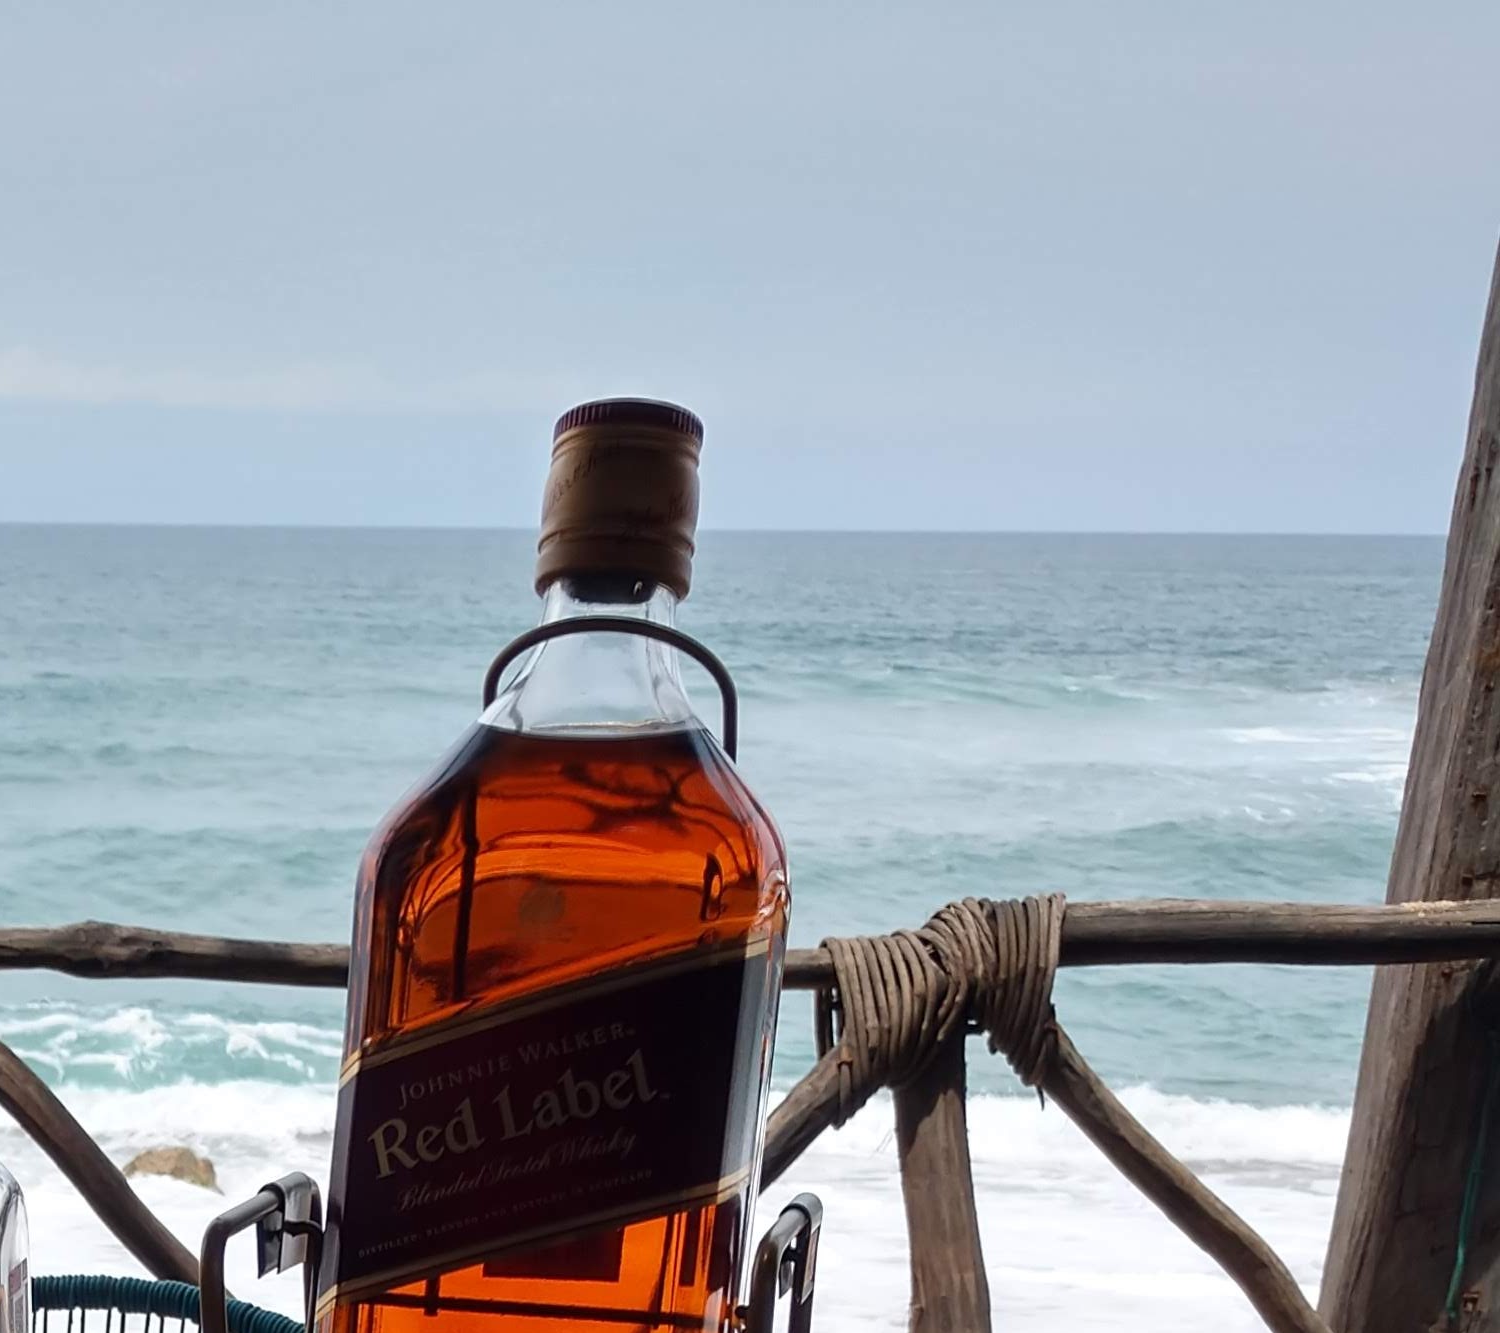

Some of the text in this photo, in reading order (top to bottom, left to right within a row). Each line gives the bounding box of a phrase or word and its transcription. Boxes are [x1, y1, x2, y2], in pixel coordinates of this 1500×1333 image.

[397, 1021, 626, 1111] JOHNNIE WALKER
[367, 1048, 658, 1180] Red Label
[393, 1126, 636, 1213] Blended Scotch Whisky
